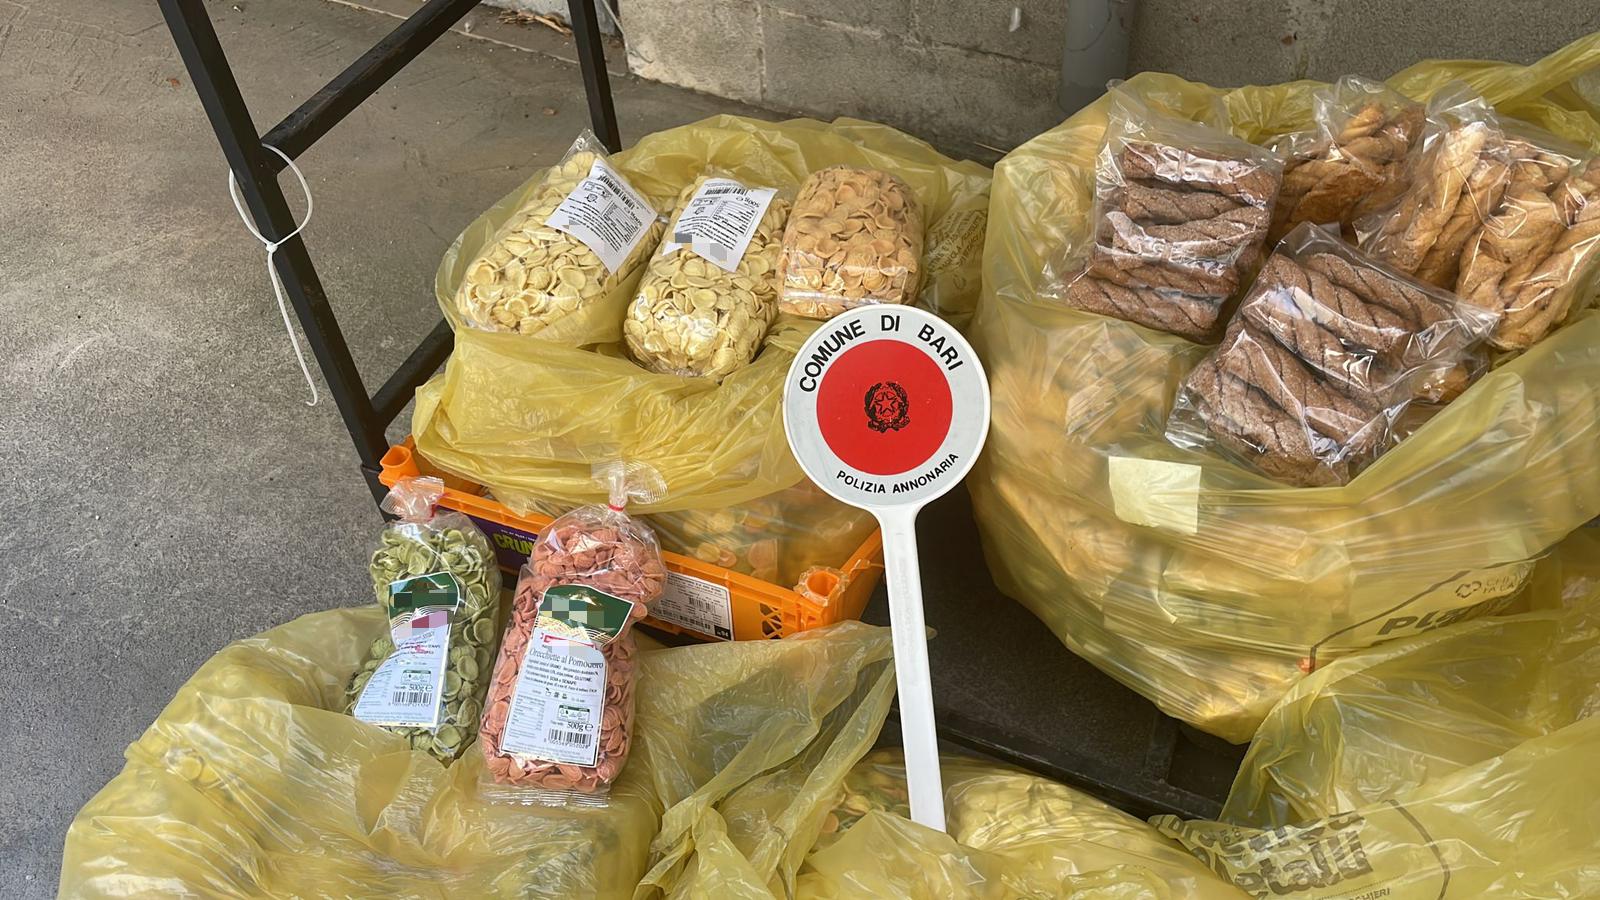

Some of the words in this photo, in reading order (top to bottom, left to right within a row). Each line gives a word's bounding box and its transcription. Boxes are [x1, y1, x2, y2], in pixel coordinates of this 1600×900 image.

[799, 319, 866, 393] COMUNE
[880, 314, 900, 332] DI
[917, 324, 964, 371] BARI
[836, 470, 886, 494] POLIZIA
[892, 453, 960, 494] ANNONARIA
[529, 647, 561, 663] Orecchiette
[561, 655, 568, 664] al
[408, 684, 425, 693] 500g
[566, 720, 584, 732] 500g
[1349, 887, 1390, 900] CHIERI
